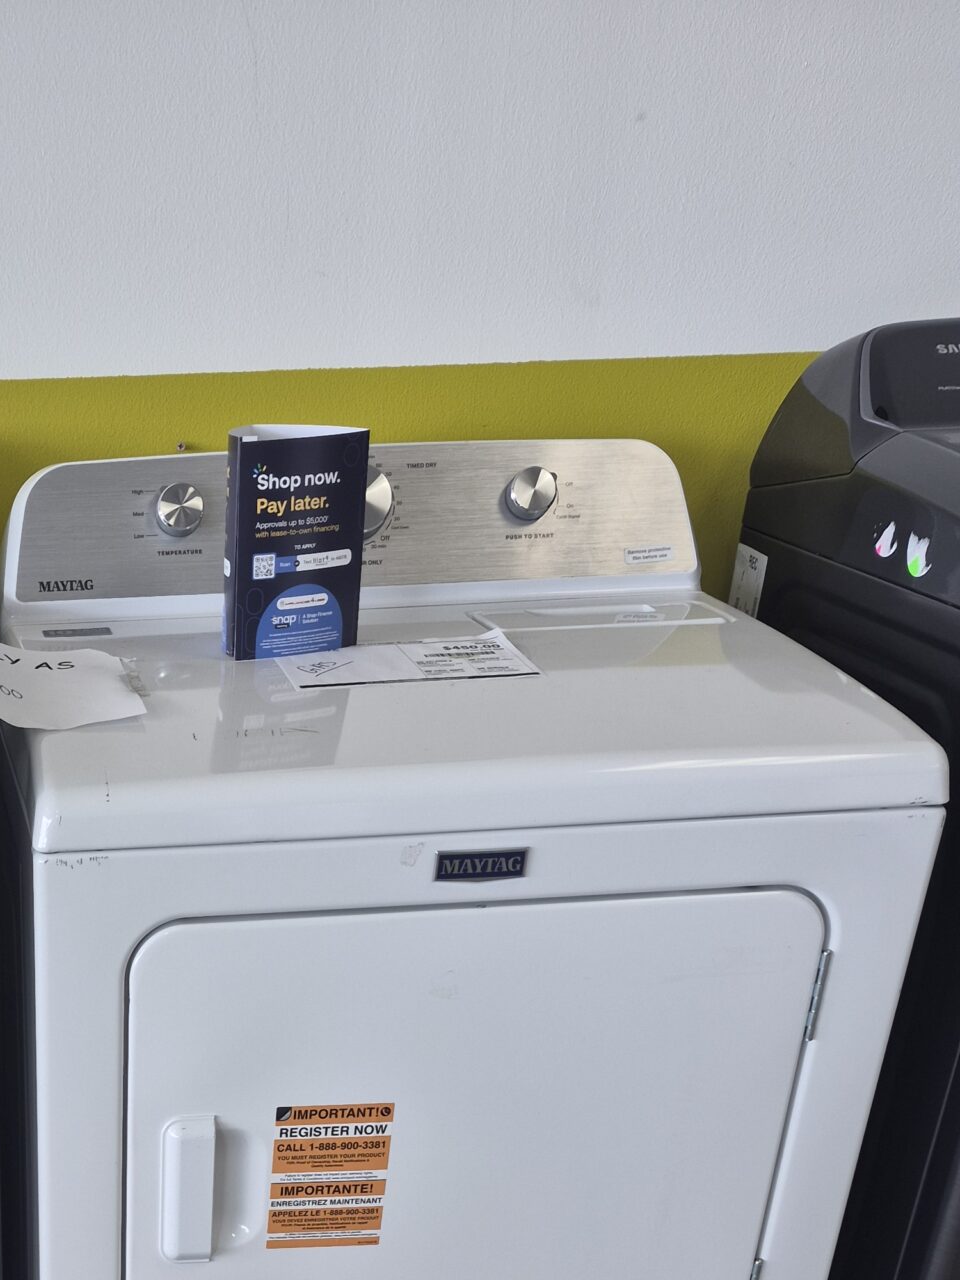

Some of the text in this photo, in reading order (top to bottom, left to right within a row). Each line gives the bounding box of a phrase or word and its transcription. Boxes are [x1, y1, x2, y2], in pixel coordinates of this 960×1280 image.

[936, 344, 960, 354] SA
[257, 471, 341, 492] Shop now.
[256, 495, 330, 516] Pay later.
[255, 521, 287, 529] Approvals
[270, 528, 312, 538] lease-to-own
[313, 524, 340, 532] financing
[38, 579, 94, 592] MAYTAG
[272, 615, 296, 626] snap
[34, 661, 76, 671] AS
[440, 856, 521, 874] MAYTAG
[293, 1107, 379, 1120] IMPORTANT!
[279, 1124, 388, 1138] REGISTER NOW
[277, 1141, 386, 1152] CALL 1-888-900-3381
[280, 1184, 373, 1196] IMPORTANTE!
[271, 1198, 382, 1207] ENREGISTREZ MAINTENANT
[323, 1208, 379, 1216] 1-888-900-3381
